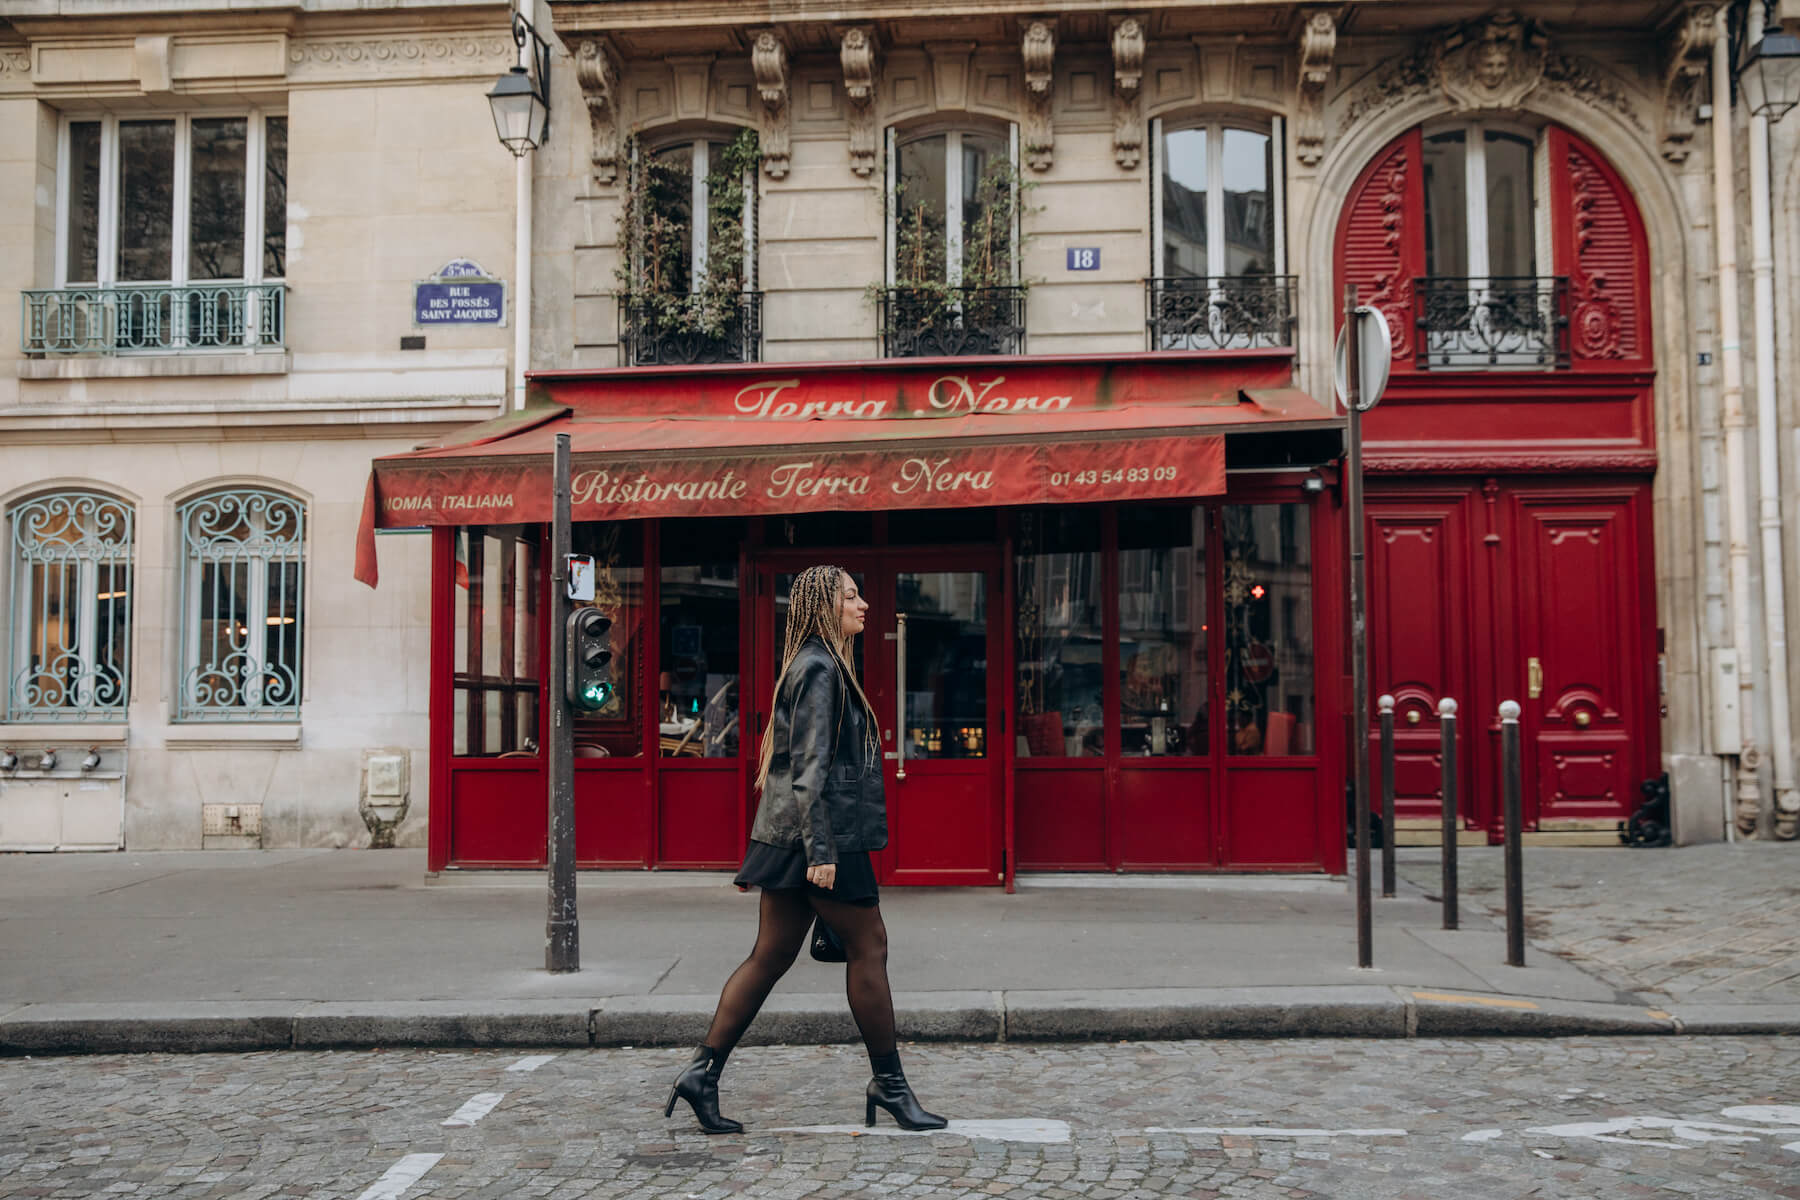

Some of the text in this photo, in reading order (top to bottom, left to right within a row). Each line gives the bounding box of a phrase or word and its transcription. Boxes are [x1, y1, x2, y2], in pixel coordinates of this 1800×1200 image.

[1073, 250, 1094, 268] 18
[449, 287, 470, 297] RUE
[430, 296, 490, 308] DES FOSSÉS
[421, 308, 498, 321] SAINT JACQUES
[571, 457, 994, 505] Ristorante Terra Nera
[1050, 466, 1177, 486] 01 43 54 83 09
[441, 493, 514, 509] ITALIANA
